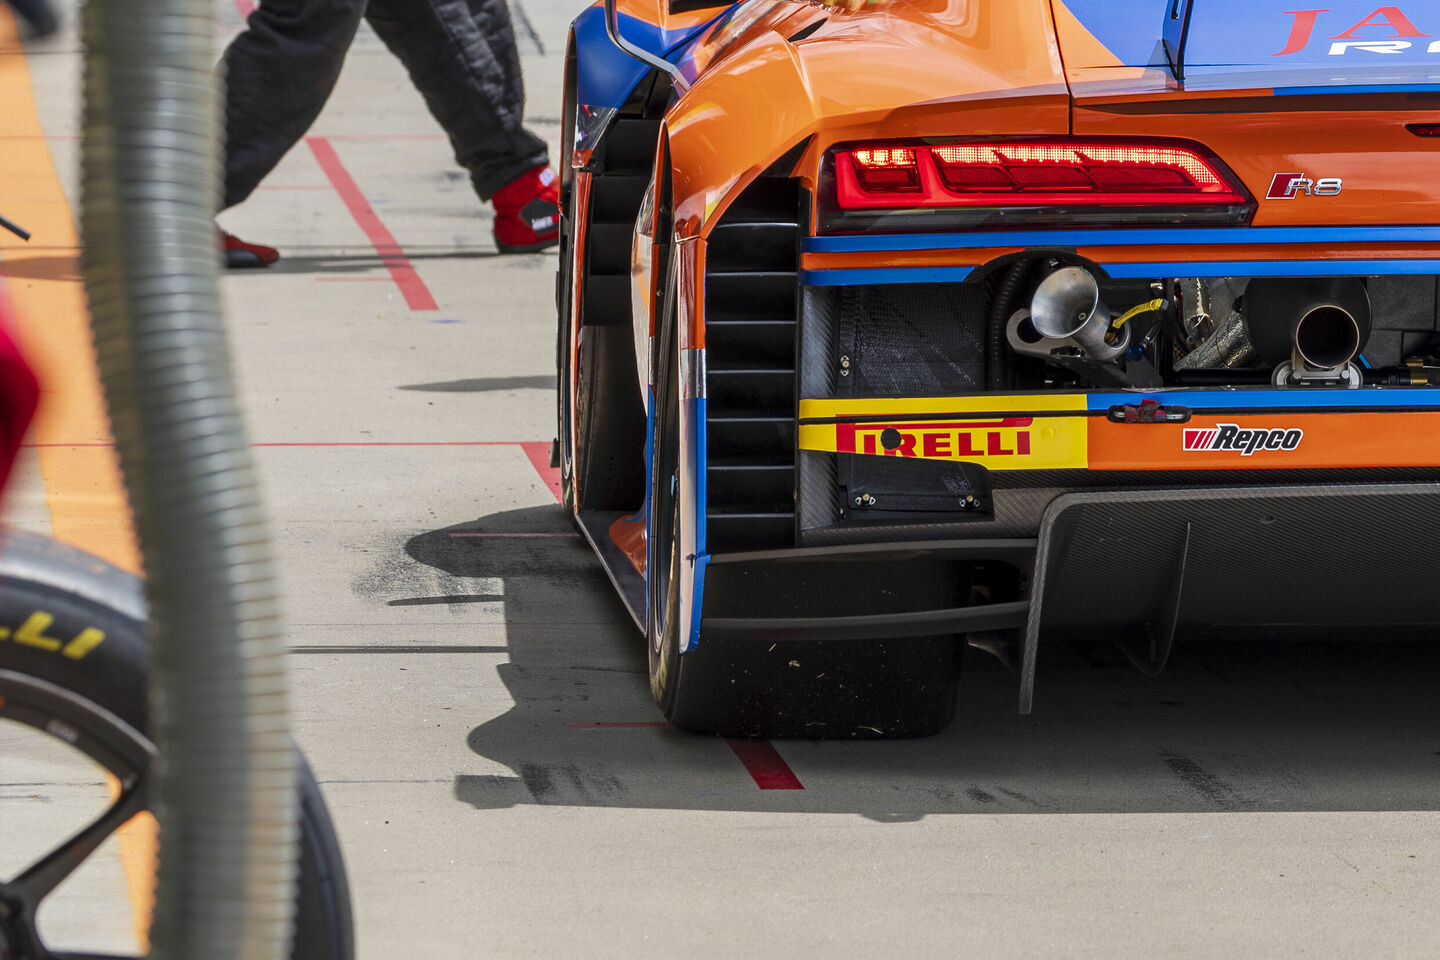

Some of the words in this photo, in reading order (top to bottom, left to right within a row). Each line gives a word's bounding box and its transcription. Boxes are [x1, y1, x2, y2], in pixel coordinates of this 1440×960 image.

[1284, 178, 1343, 196] R8
[836, 414, 1032, 458] PIRELLI
[1214, 424, 1304, 455] Repco
